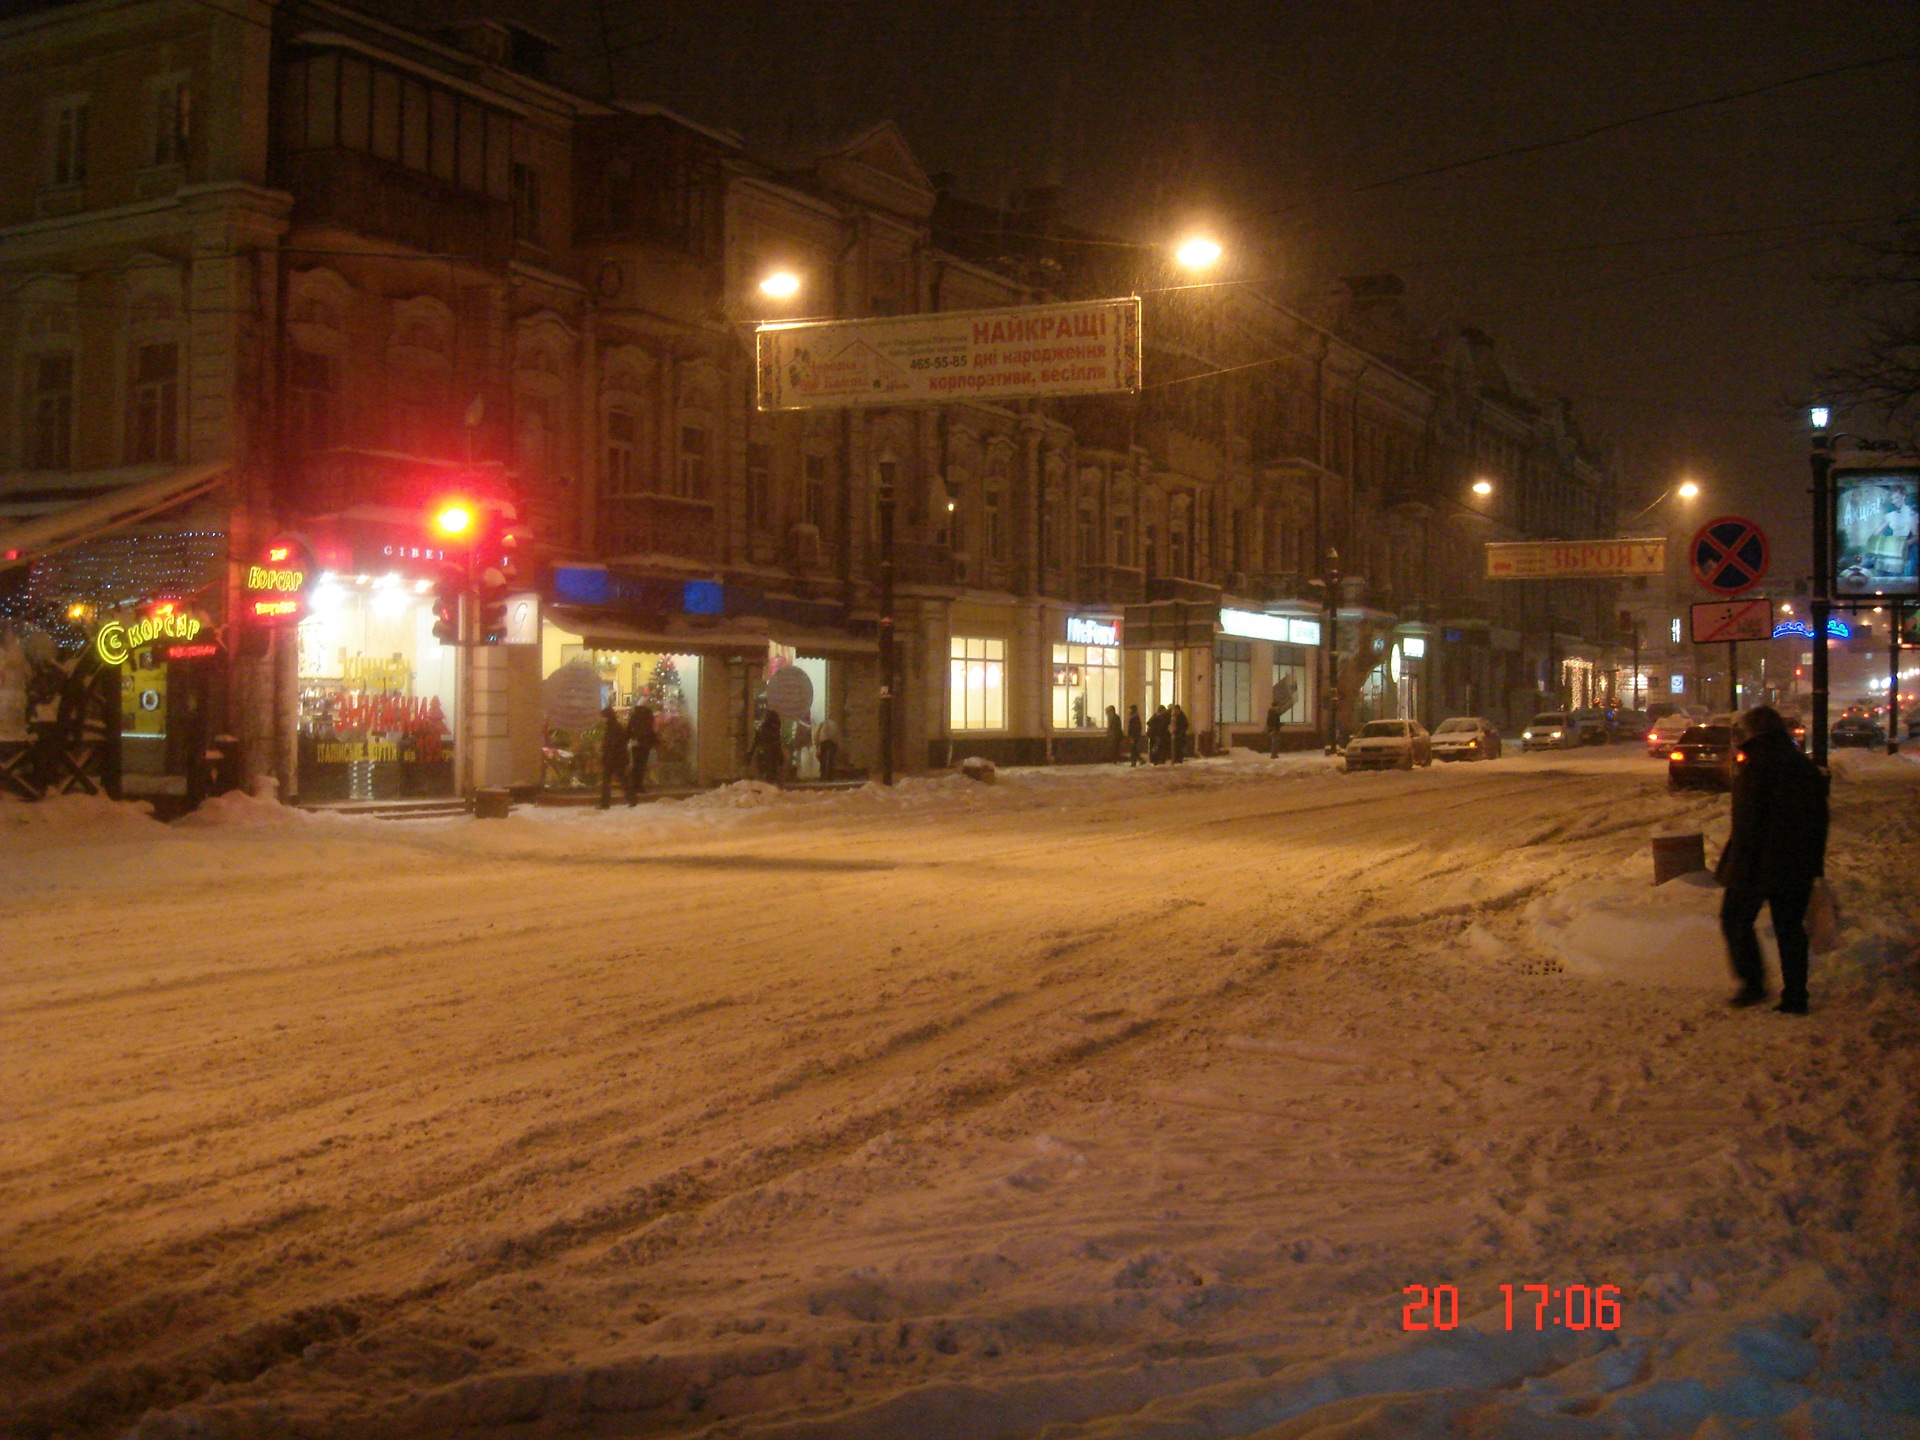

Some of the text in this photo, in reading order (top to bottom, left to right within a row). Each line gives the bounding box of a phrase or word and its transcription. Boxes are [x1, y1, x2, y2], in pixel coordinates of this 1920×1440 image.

[972, 313, 1107, 345] НАЙКРАЩІ
[909, 355, 968, 370] 465-55-85
[972, 345, 1106, 369] дні народження
[1040, 364, 1106, 384] весілля
[1552, 546, 1632, 570] ЗБРОЯ
[248, 566, 304, 592] КОРСАР
[127, 614, 201, 648] КОРСАР
[332, 694, 428, 732] ЗНИЖКИ
